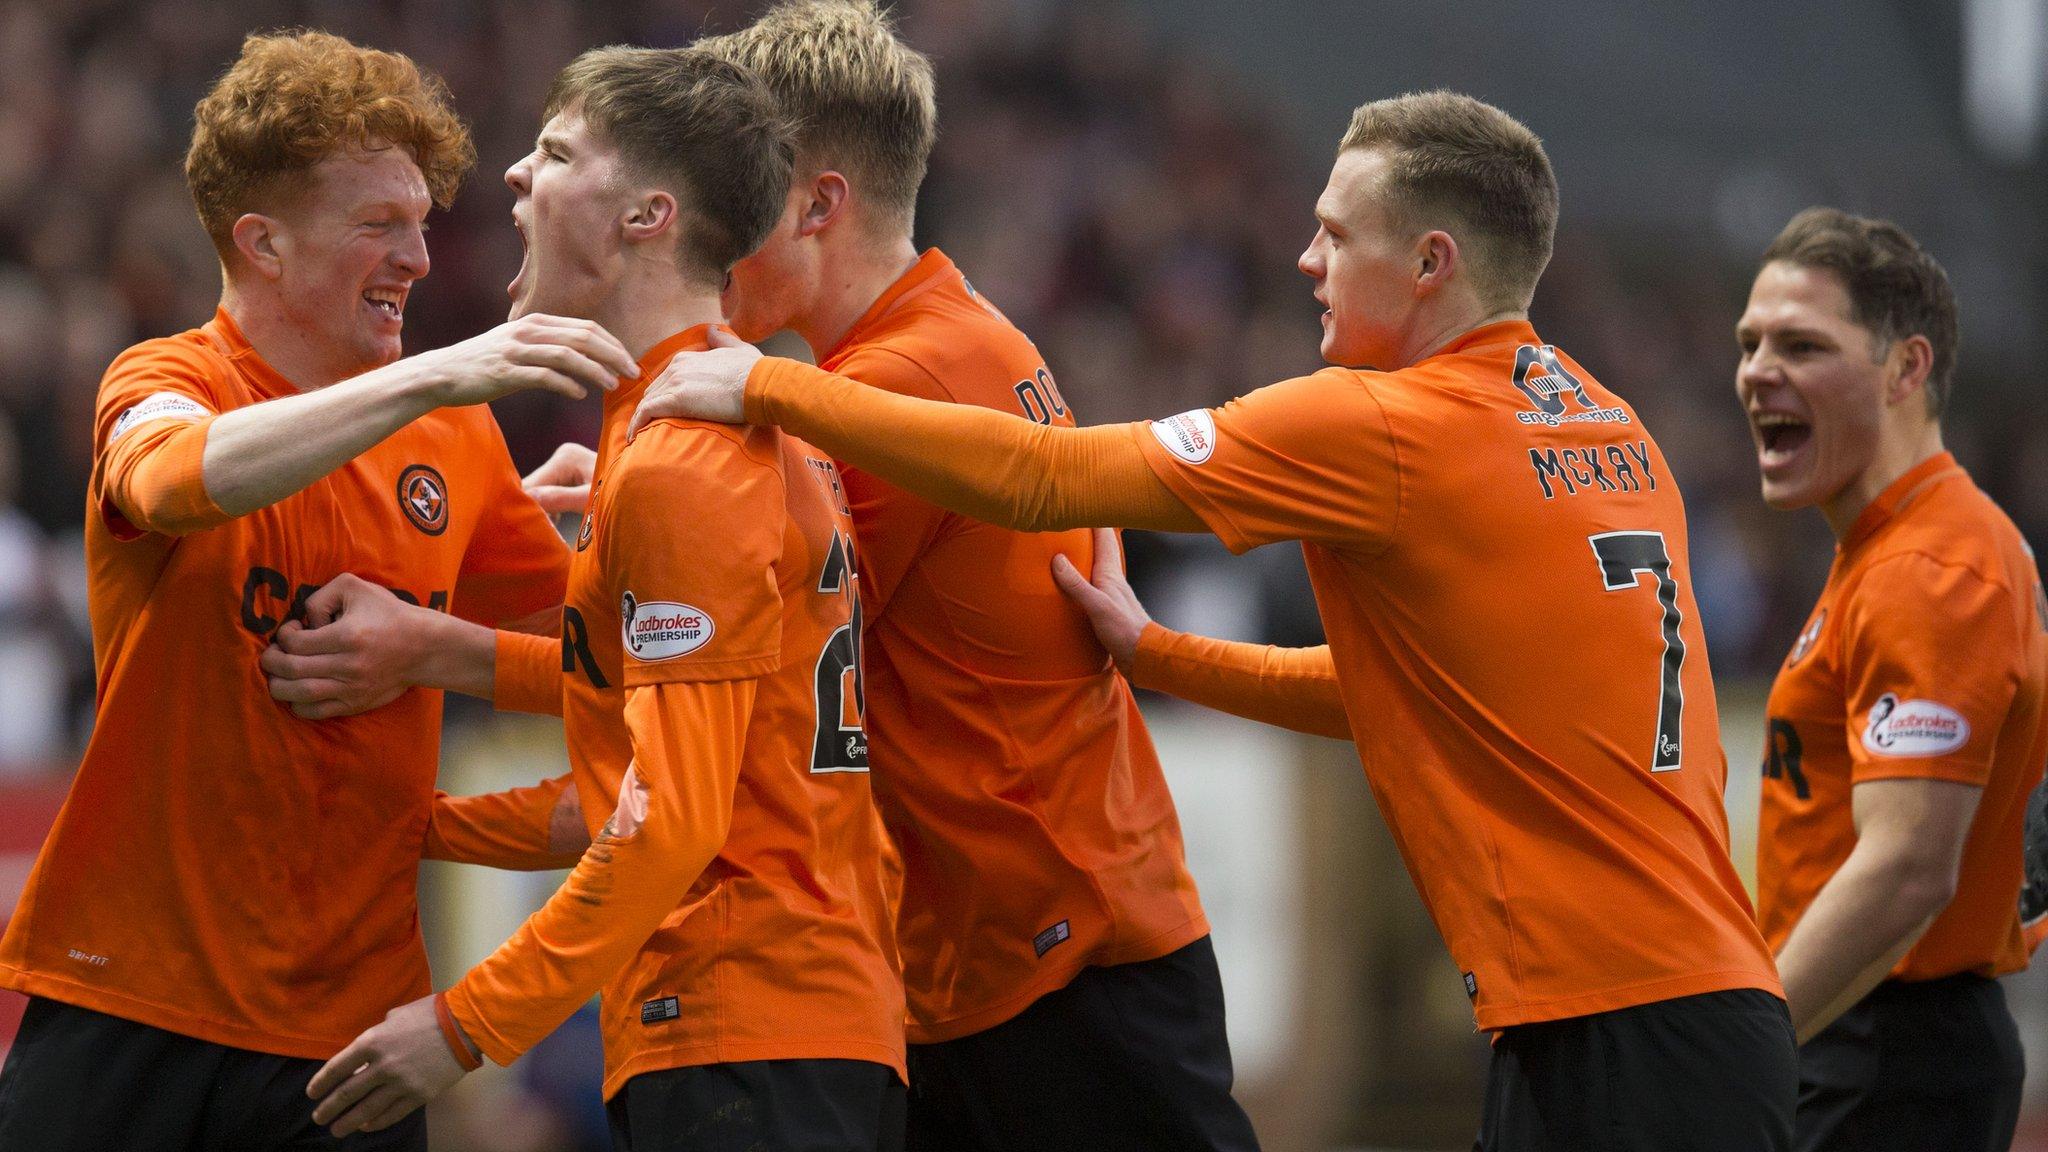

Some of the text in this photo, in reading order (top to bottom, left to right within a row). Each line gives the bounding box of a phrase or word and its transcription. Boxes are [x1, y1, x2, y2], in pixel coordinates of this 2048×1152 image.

[1527, 440, 1656, 499] MCKAY
[635, 614, 702, 633] Ladbrokes
[635, 629, 702, 645] PREMIERSHIP
[1587, 530, 1686, 772] 7
